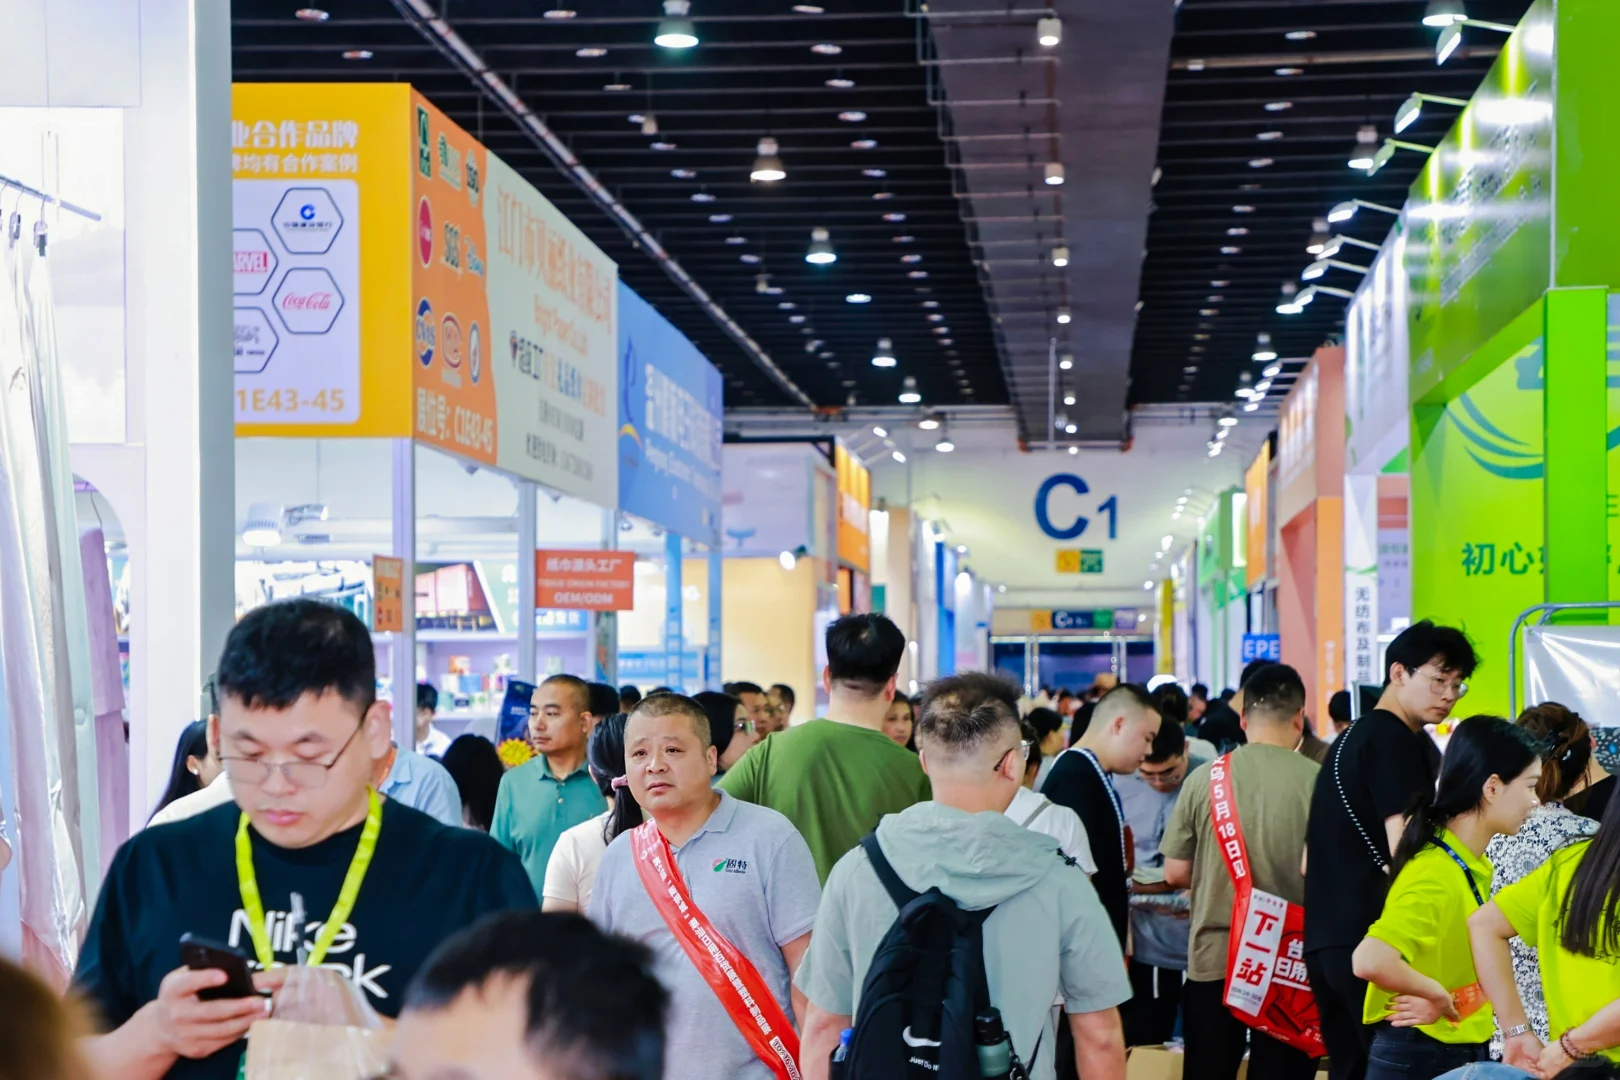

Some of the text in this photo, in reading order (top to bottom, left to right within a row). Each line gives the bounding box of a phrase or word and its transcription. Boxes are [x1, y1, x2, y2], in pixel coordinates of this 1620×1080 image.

[232, 120, 359, 148] 业合作品牌
[236, 388, 345, 412] 1E43-45
[1034, 472, 1118, 540] C1
[1461, 541, 1544, 577] 初心
[1243, 639, 1280, 659] EPE
[1235, 909, 1280, 987] 下一站
[1274, 956, 1310, 984] 日用
